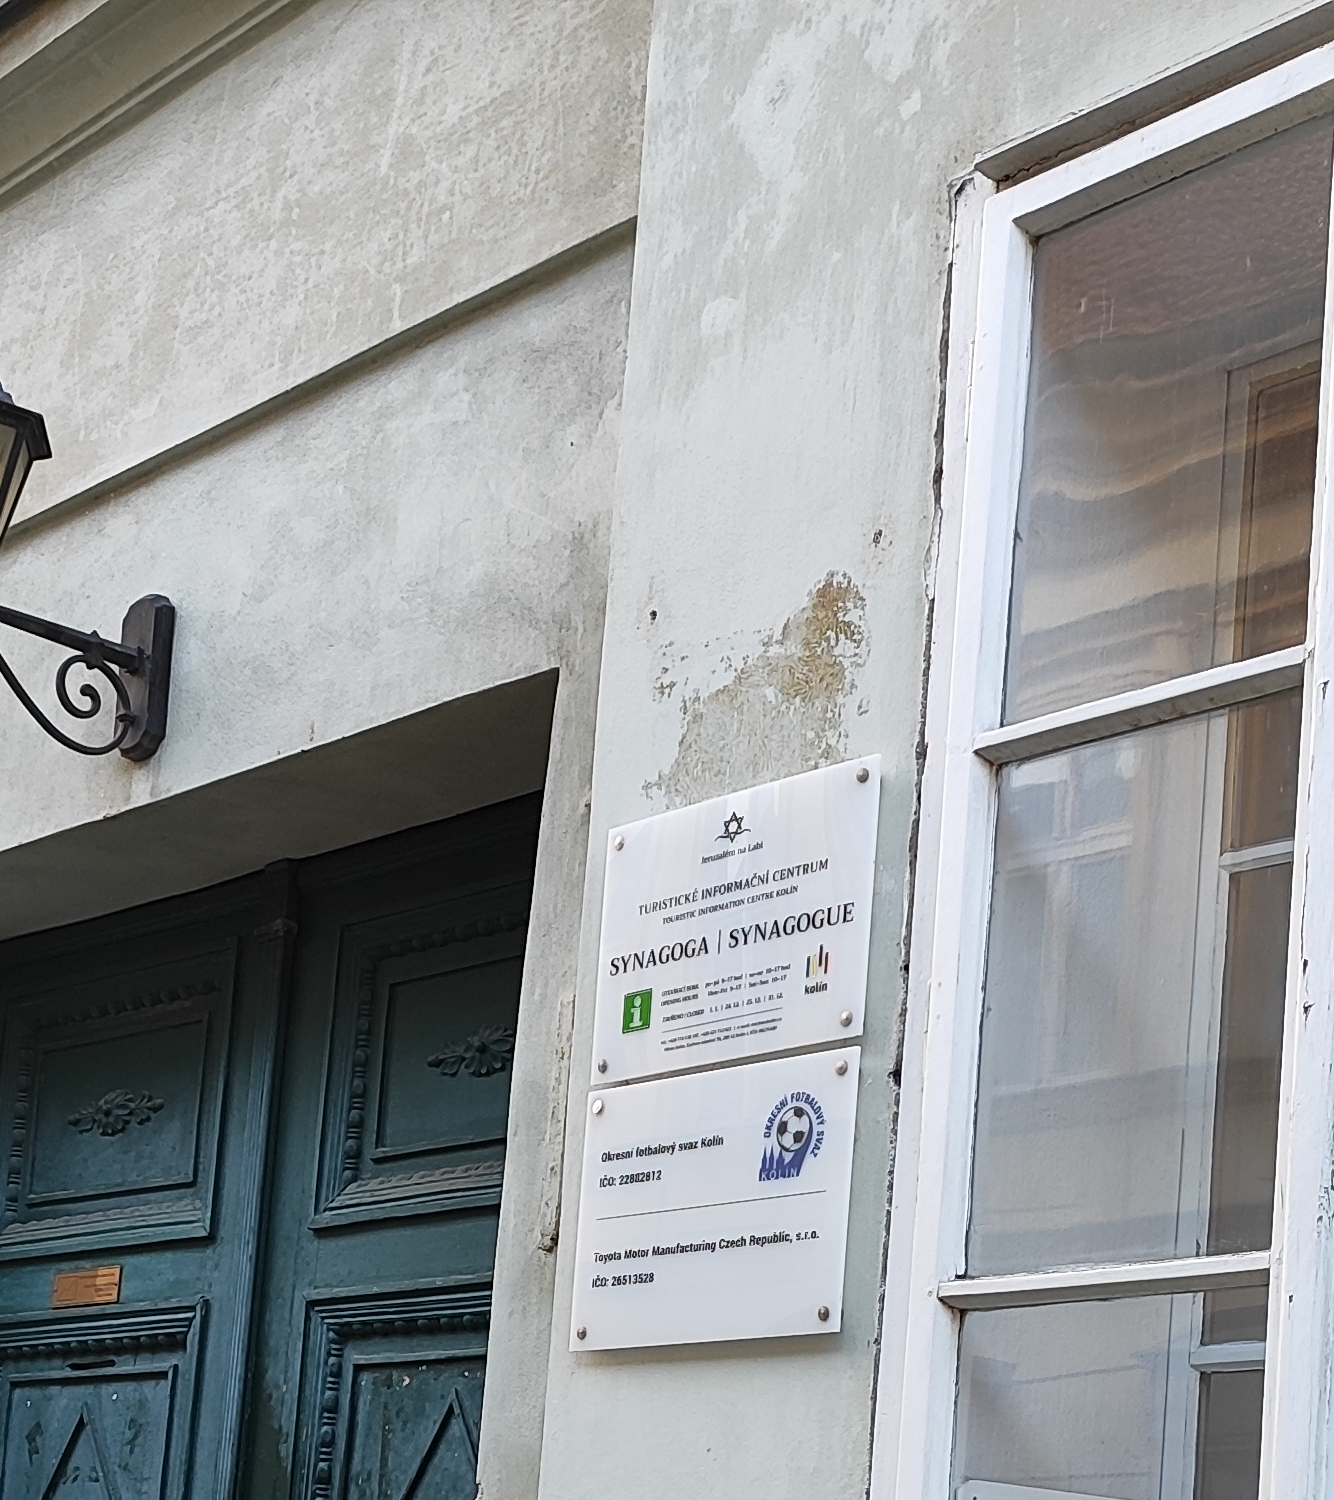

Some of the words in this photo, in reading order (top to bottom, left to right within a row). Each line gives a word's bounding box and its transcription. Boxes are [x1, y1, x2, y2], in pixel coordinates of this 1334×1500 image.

[702, 849, 735, 864] Jeruzalém
[738, 846, 746, 855] na
[748, 840, 763, 852] Labi
[639, 887, 698, 916] TURISTICKÉ
[702, 870, 769, 901] INFORMAČNÍ
[773, 858, 828, 882] CENTRUM
[663, 909, 696, 925] TOURISTIC
[698, 898, 745, 917] INFORMATION
[747, 890, 774, 904] CENTRE
[776, 885, 798, 897] KOLÍN
[610, 936, 708, 977] SYNAGOGA
[729, 902, 854, 949] SYNAGOGUE
[804, 981, 828, 995] kolín
[764, 1094, 788, 1138] OKRESNÍ
[810, 1131, 825, 1158] SVAZ
[602, 1150, 633, 1163] Okresní
[636, 1142, 676, 1158] fotbalový
[678, 1141, 698, 1152] svaz
[701, 1135, 723, 1148] Kolín
[594, 1251, 621, 1264] Toyota
[624, 1249, 649, 1259] Motor
[652, 1240, 716, 1256] Manufacturing
[719, 1236, 746, 1250] Czech
[749, 1230, 792, 1248] Republic,
[611, 1272, 654, 1287] 26513528
